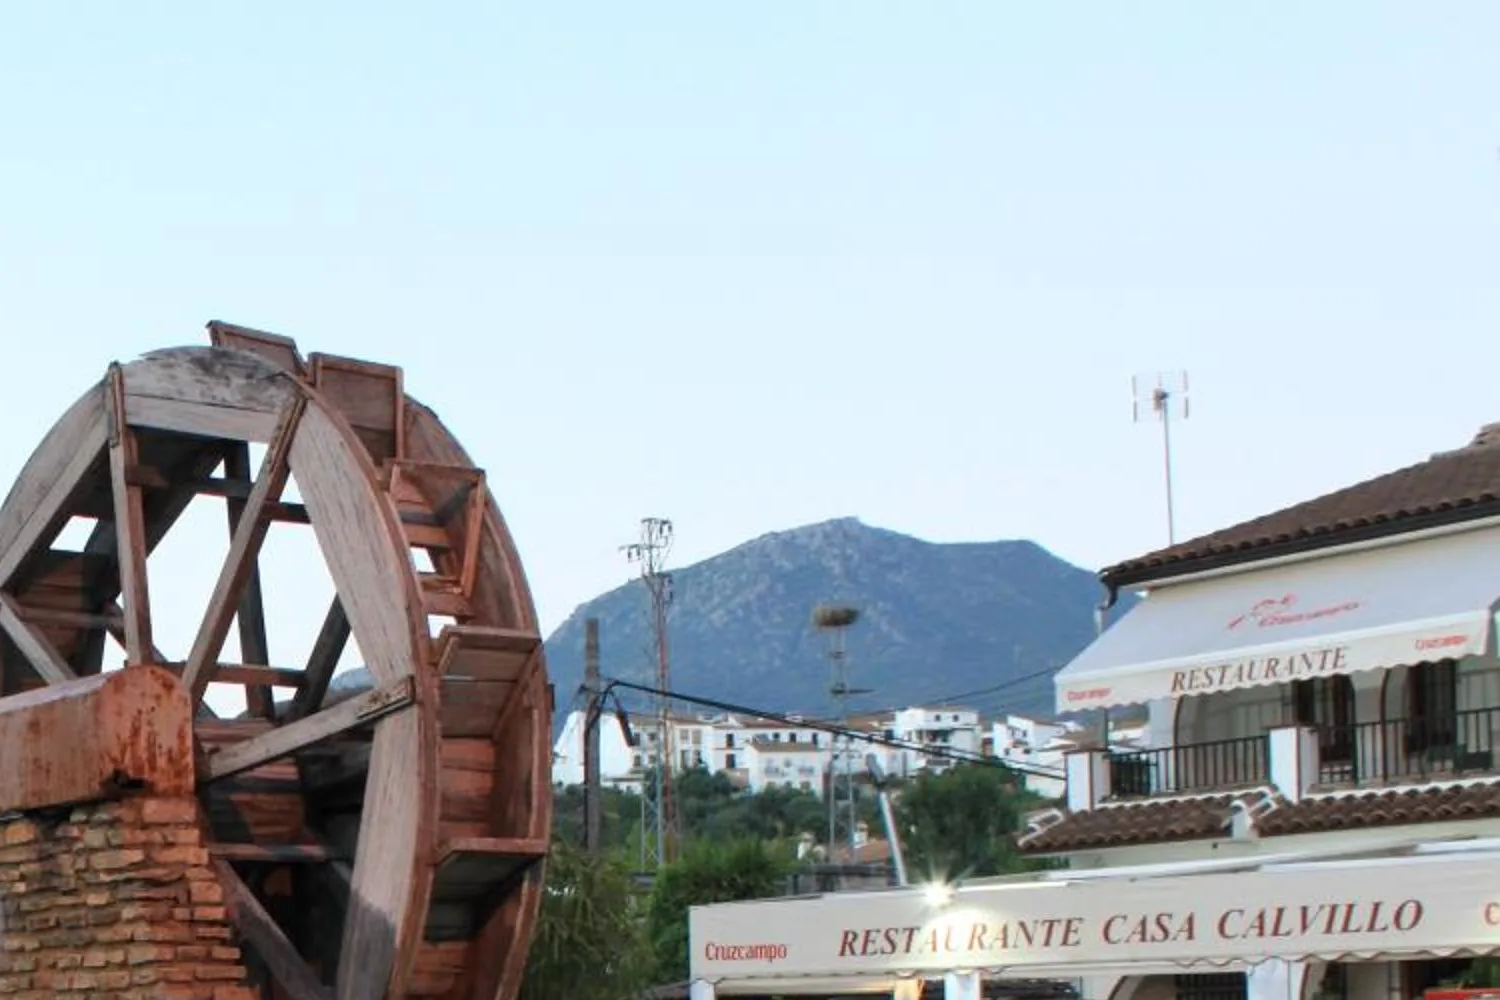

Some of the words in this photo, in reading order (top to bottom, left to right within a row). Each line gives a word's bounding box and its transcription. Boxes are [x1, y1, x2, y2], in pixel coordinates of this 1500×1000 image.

[1171, 647, 1347, 693] RESTAURANTE
[838, 917, 1084, 957] RESTAURANTE
[1102, 911, 1197, 945] CASA
[1217, 899, 1424, 940] CALVILLO
[705, 941, 788, 963] Cruzcampo
